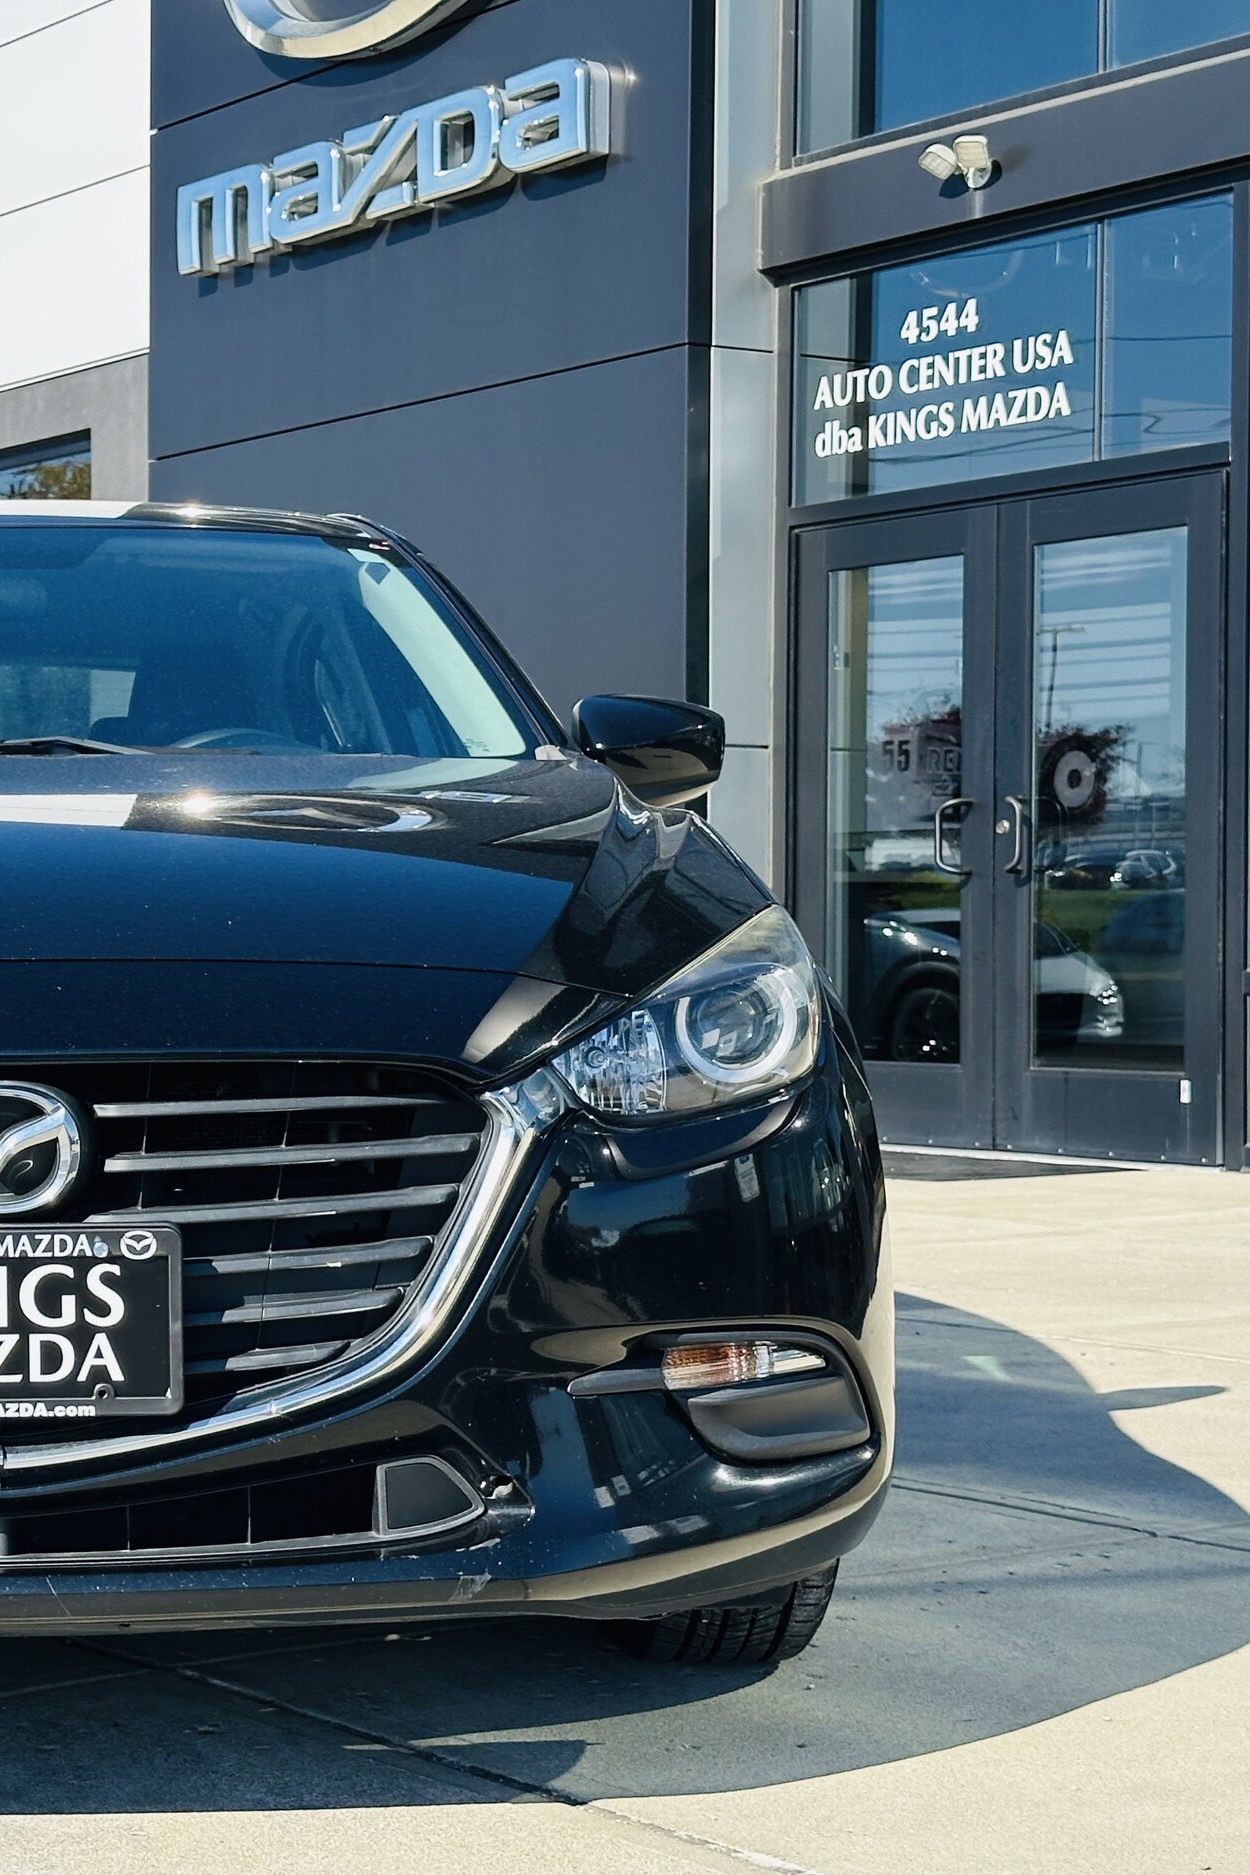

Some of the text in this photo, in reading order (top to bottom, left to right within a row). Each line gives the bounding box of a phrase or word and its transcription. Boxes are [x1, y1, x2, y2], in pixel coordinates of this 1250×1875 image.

[900, 299, 979, 344] 4544
[813, 330, 1075, 411] AUTO CENTER USA
[814, 381, 1072, 458] dba KINGS MAZDA
